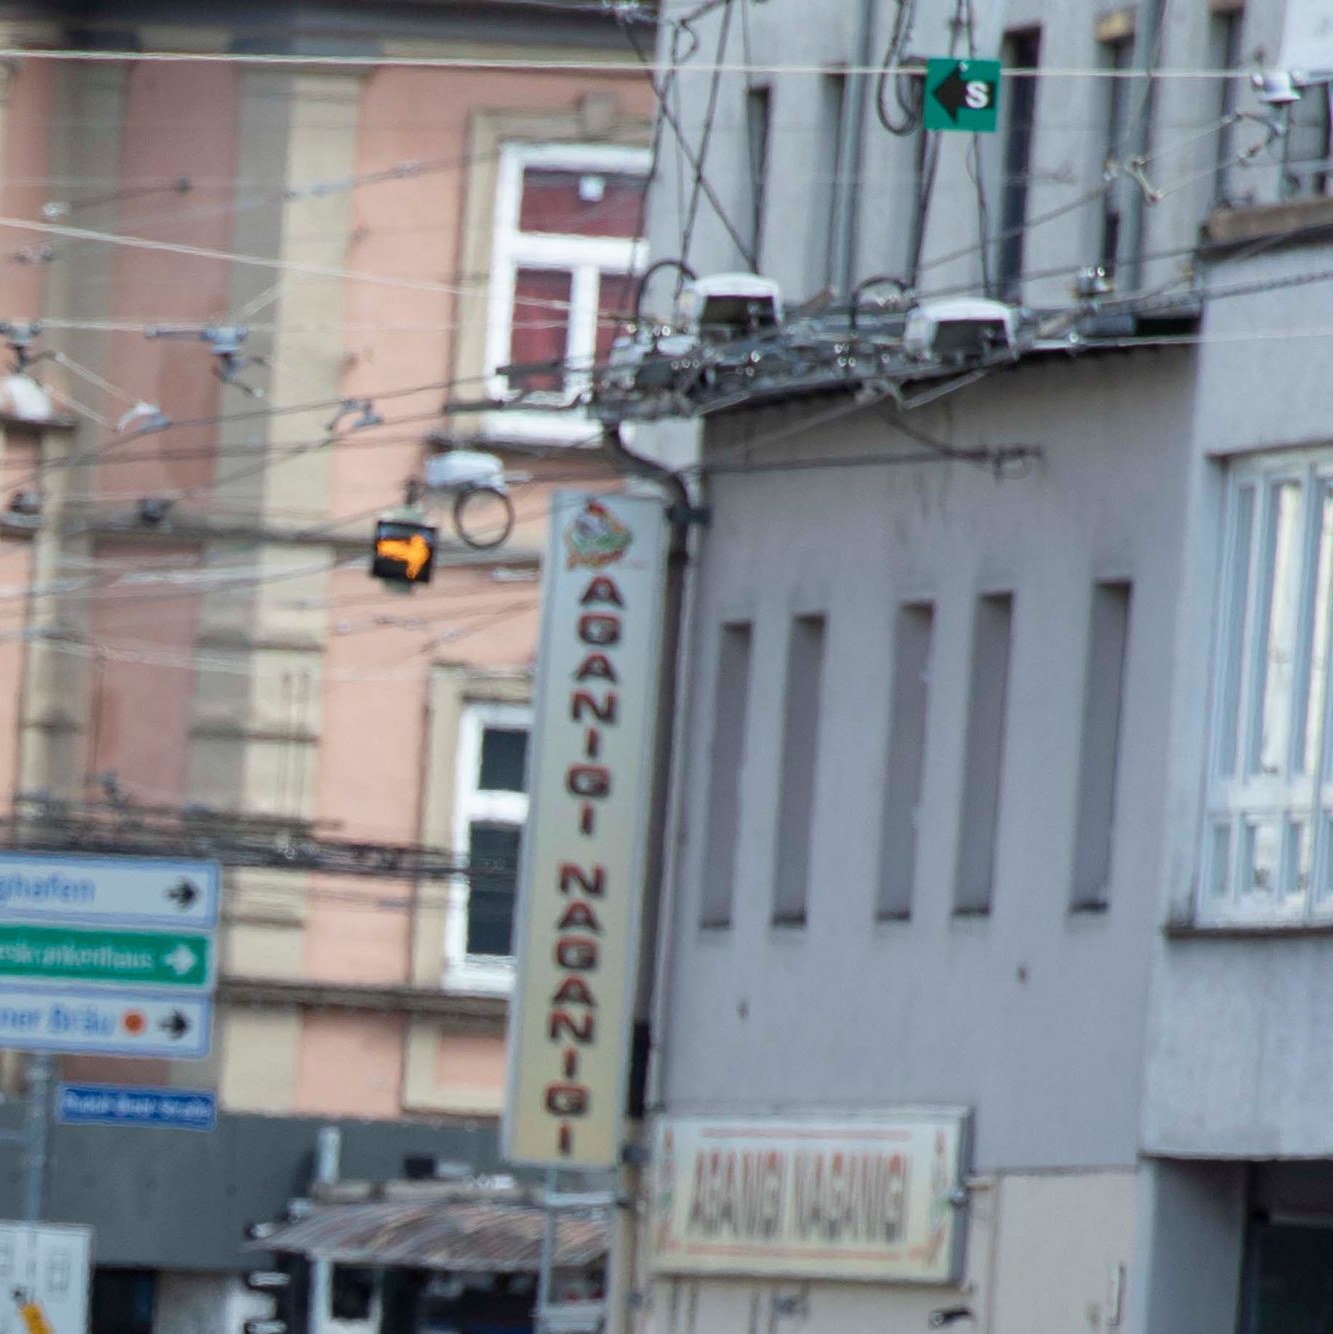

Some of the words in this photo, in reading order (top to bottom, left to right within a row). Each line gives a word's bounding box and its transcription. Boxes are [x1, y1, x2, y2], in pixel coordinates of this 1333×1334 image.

[964, 80, 989, 109] S
[566, 575, 626, 836] AGANIGI
[544, 861, 606, 1154] NAGANIGI
